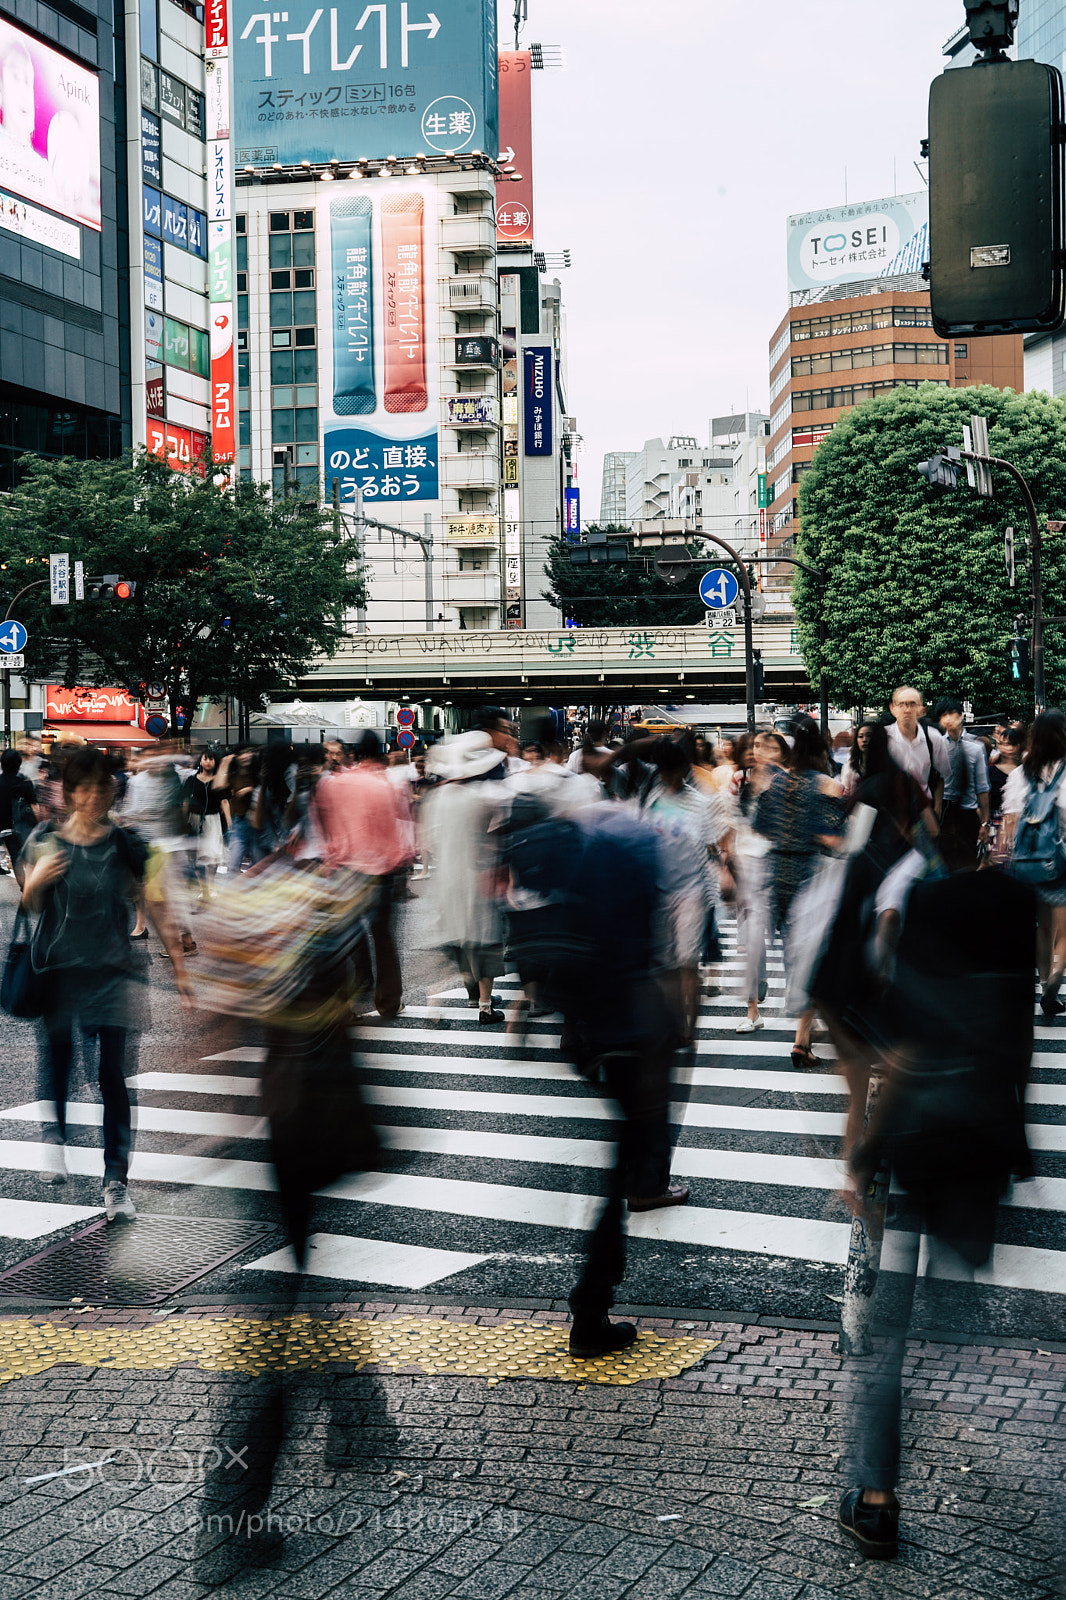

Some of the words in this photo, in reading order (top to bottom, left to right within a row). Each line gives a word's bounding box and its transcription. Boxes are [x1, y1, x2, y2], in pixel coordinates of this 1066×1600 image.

[210, 0, 224, 46] イフル
[240, 4, 440, 77] ダイレクト
[58, 73, 91, 106] Apink
[258, 86, 342, 109] スティック
[349, 87, 383, 100] ミント
[388, 84, 416, 98] 16包
[257, 103, 417, 122] のどのあれ・不快感に水なしで飲める
[426, 111, 472, 136] 生薬
[215, 144, 225, 217] レオパレス21
[144, 198, 201, 247] レオパレス21
[498, 212, 528, 227] 生薬
[811, 226, 887, 255] TOSEI
[214, 252, 228, 295] レイク
[812, 248, 887, 269] トーセイ株式会社
[346, 247, 369, 361] 龍角散ダイレクト
[397, 244, 421, 359] 龍角散ダイレクト
[876, 320, 889, 329] 11F
[165, 331, 188, 356] レイク
[534, 354, 544, 399] MIZUHO
[215, 383, 230, 428] アコム
[533, 406, 543, 448] みずほ銀行
[151, 430, 190, 463] アコム
[329, 446, 436, 470] のど、直接、
[340, 474, 420, 498] うるおう
[507, 523, 518, 533] 3F
[569, 498, 578, 529] MIZUHO
[58, 558, 67, 600] 渋谷駅前
[548, 637, 576, 653] JR
